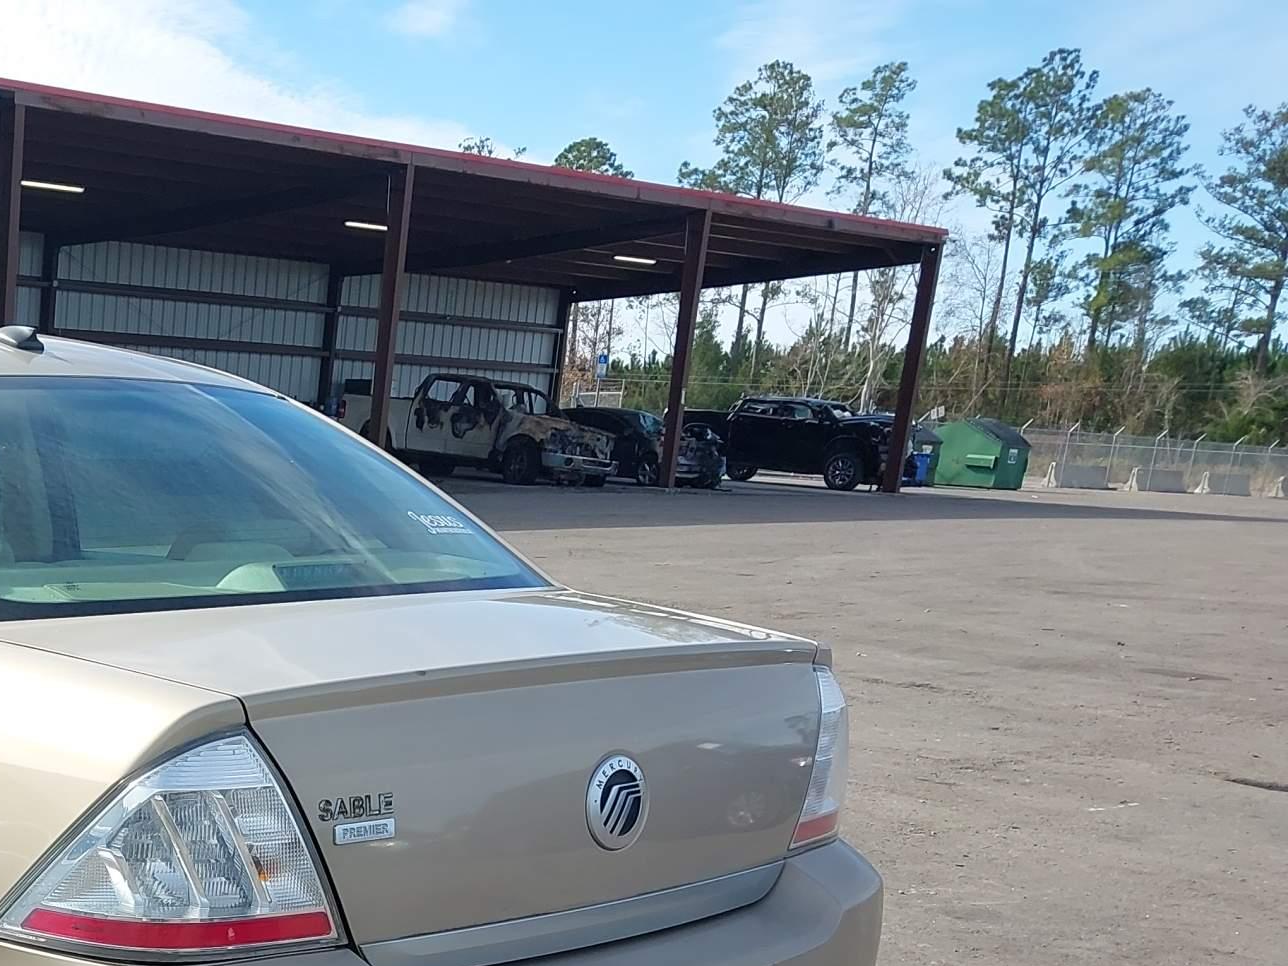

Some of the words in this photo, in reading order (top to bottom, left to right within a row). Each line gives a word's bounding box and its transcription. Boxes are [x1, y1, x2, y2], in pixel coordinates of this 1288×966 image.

[407, 511, 464, 535] Jesus
[596, 759, 644, 790] MERCURY
[318, 792, 394, 821] SABLE
[342, 823, 389, 839] PREMIER
